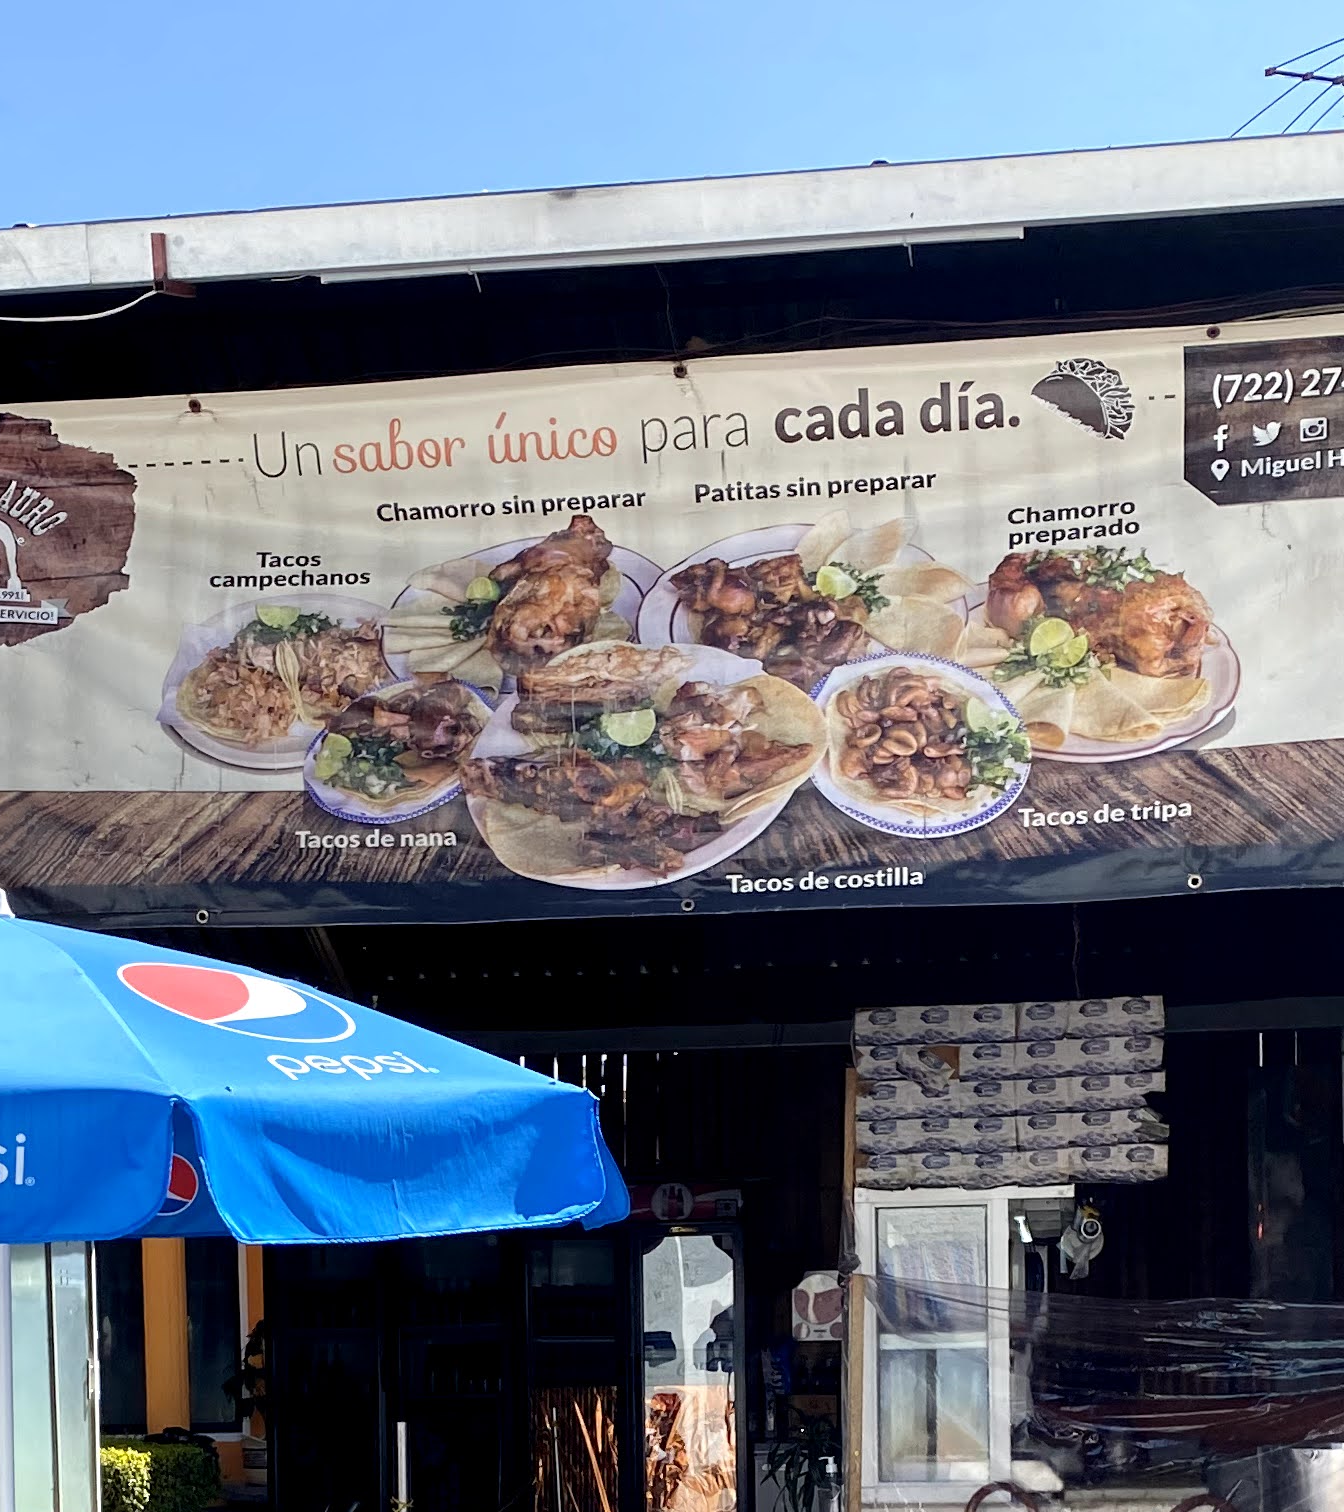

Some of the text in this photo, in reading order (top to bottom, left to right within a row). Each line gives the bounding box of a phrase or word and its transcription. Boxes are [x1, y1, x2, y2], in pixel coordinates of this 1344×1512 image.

[1213, 368, 1294, 409] (722)
[253, 381, 1021, 478] Un sabor único para cada día.
[1241, 451, 1321, 478] Miguel
[694, 471, 937, 504] Patitas sin preparar
[376, 490, 647, 523] Chamorro sin preparar
[1007, 500, 1136, 526] Chamorro
[1008, 518, 1140, 549] preparado
[257, 551, 321, 569] Tacos
[209, 569, 371, 591] campechanos
[1018, 800, 1192, 828] Tacos de tripa
[295, 829, 457, 849] Tacos de nana
[725, 866, 924, 894] Tacos de costilla
[267, 1051, 431, 1081] pepsi
